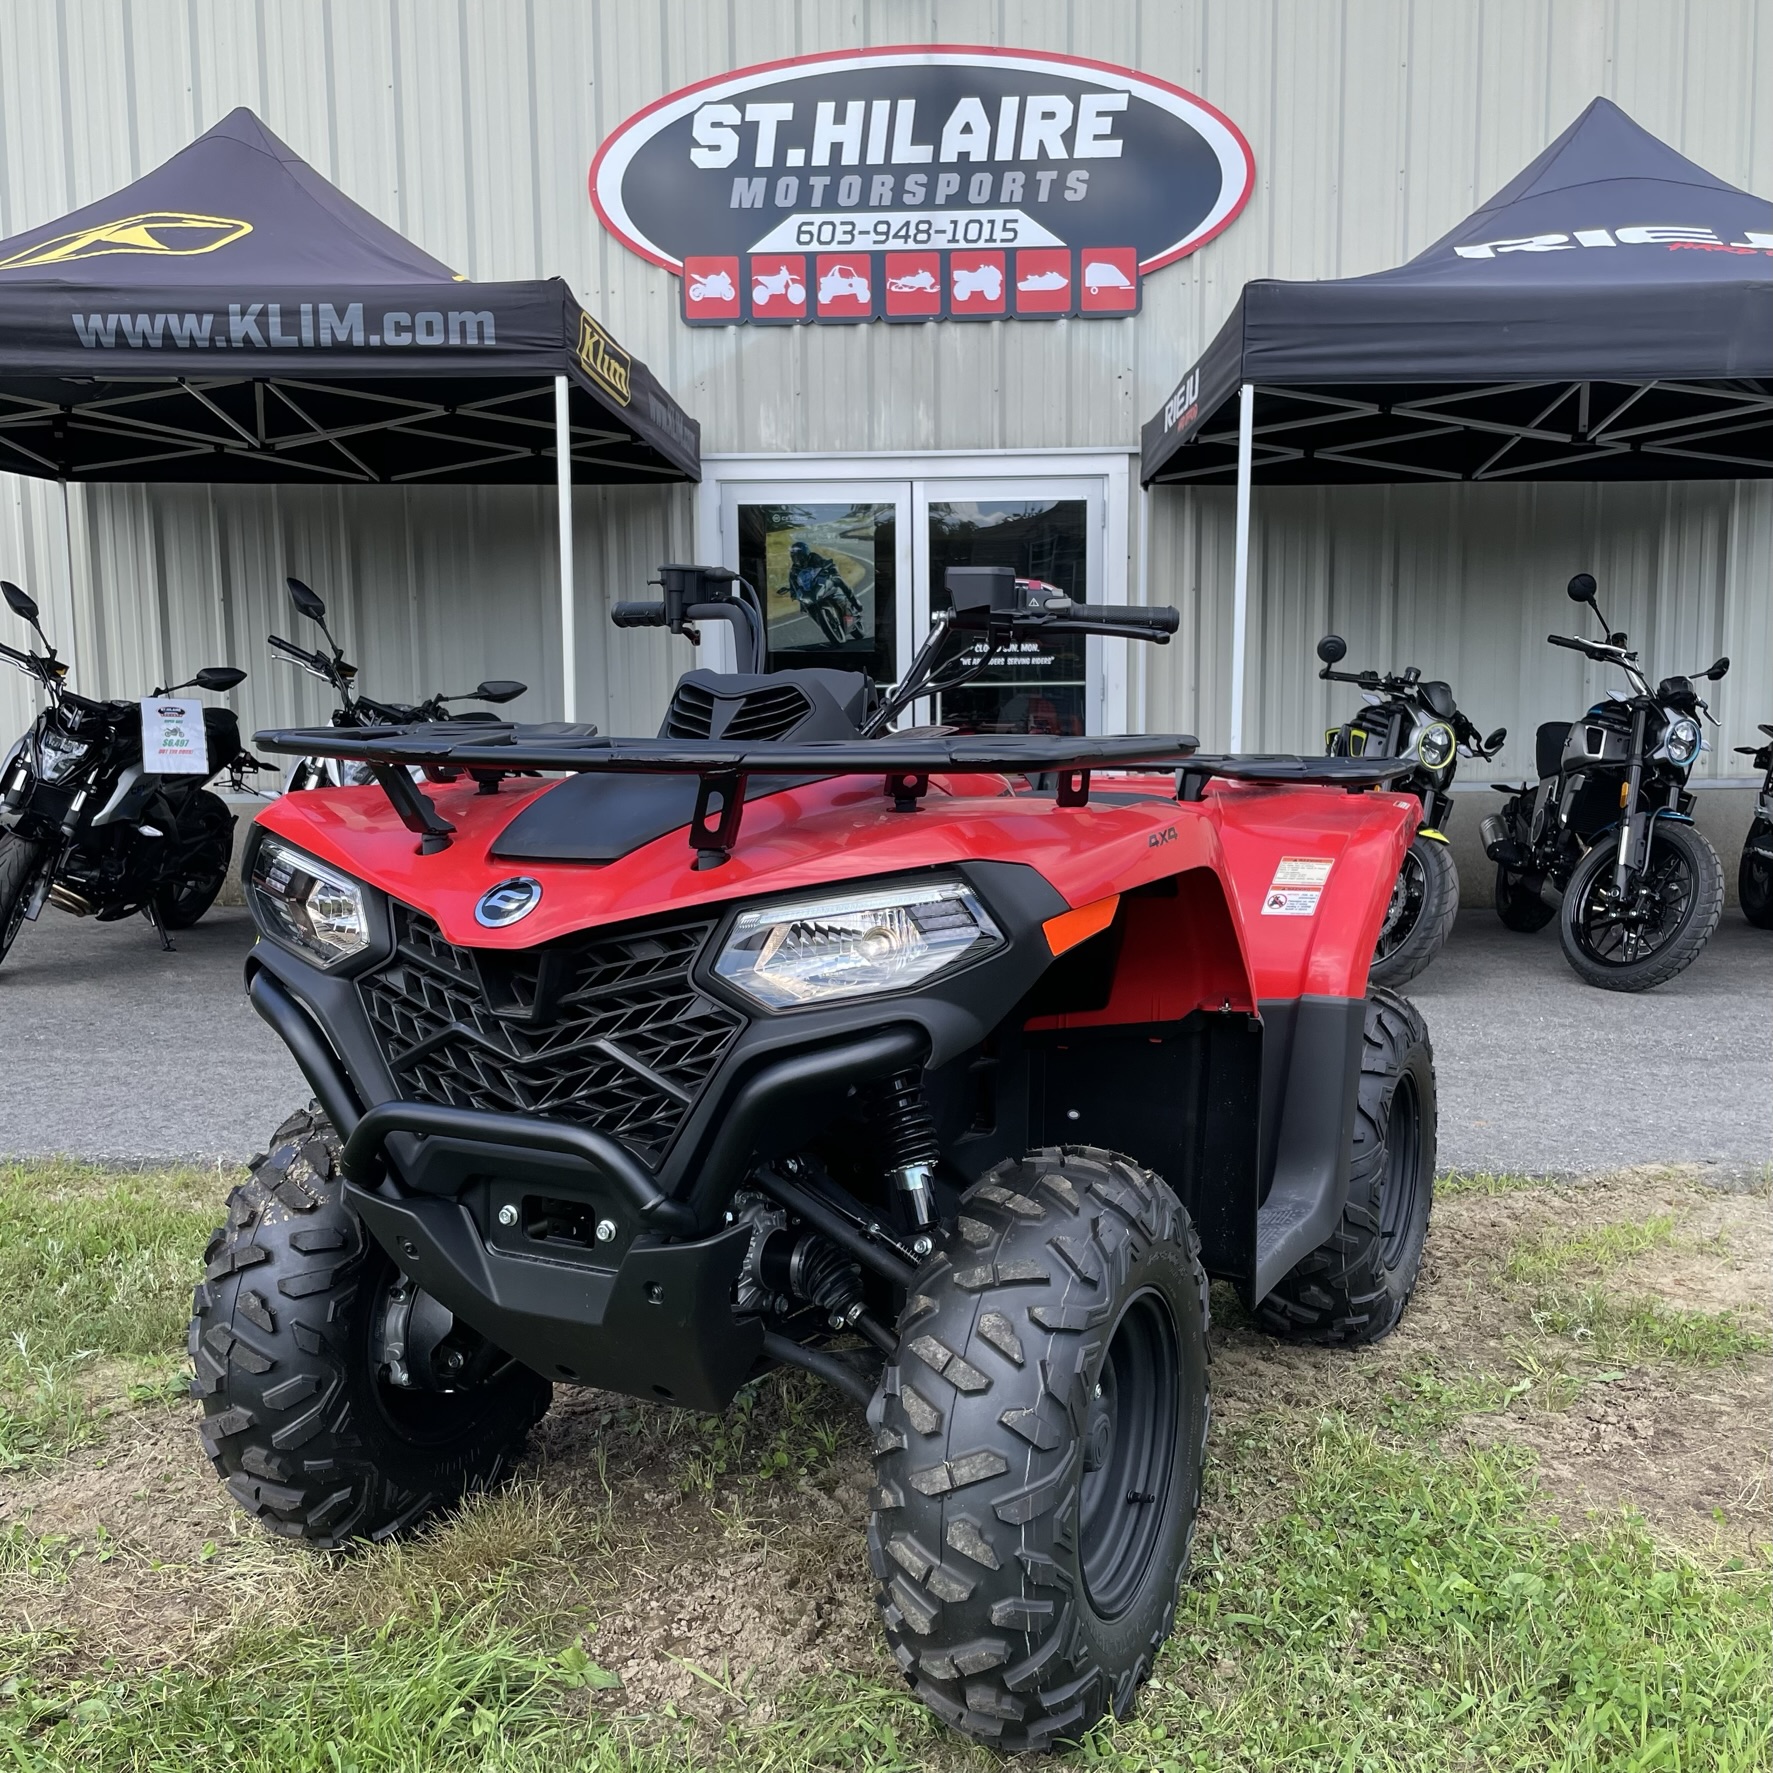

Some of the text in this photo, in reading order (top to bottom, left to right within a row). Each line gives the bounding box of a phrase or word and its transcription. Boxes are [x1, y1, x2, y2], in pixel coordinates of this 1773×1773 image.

[690, 93, 1129, 169] ST.HILAIRE
[730, 170, 1090, 208] MOTORSPORTS
[796, 219, 1019, 246] 603-948-1015
[72, 303, 496, 348] www.KLIM.com
[581, 322, 629, 398] Klim
[1164, 367, 1200, 433] RIEJU
[1006, 657, 1031, 665] SERVING
